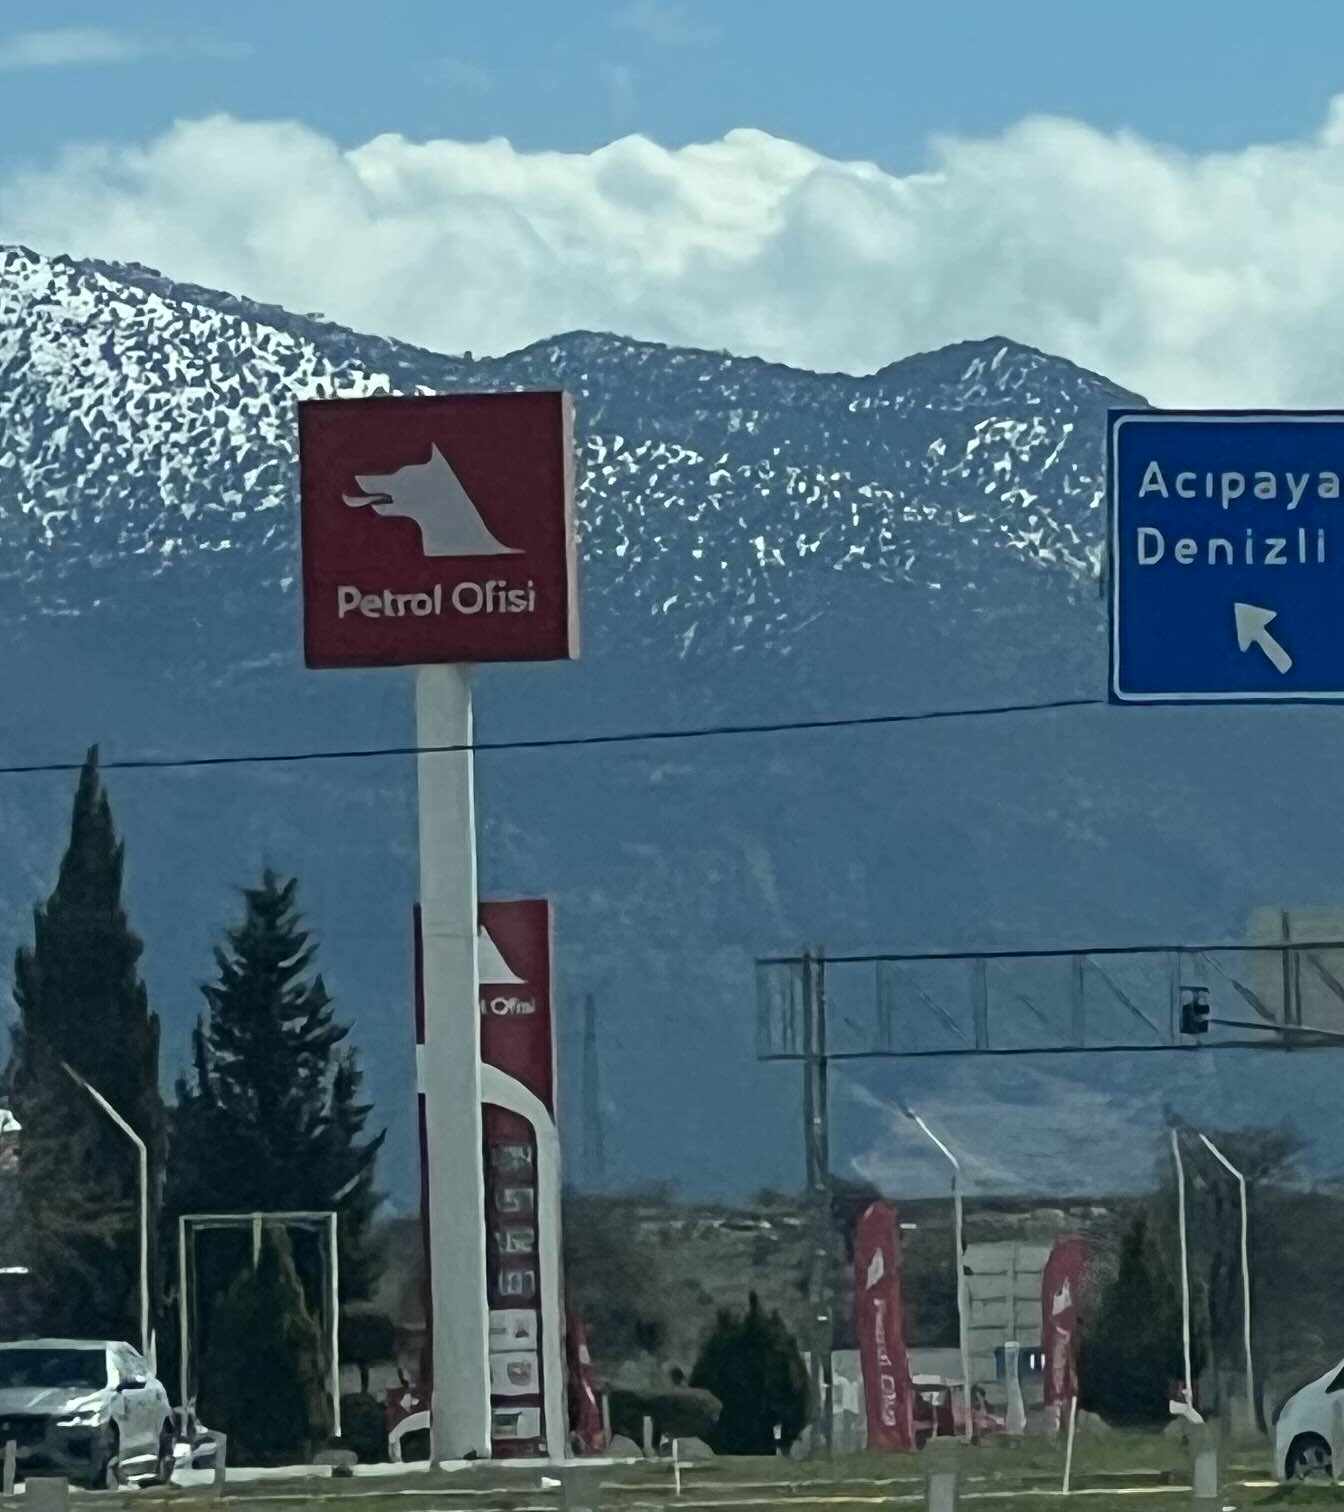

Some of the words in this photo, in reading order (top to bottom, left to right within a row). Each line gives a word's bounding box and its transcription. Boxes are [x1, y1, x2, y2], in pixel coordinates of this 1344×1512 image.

[1137, 527, 1325, 565] Denizli
[337, 584, 442, 618] Petrol
[452, 580, 536, 614] Ofisi
